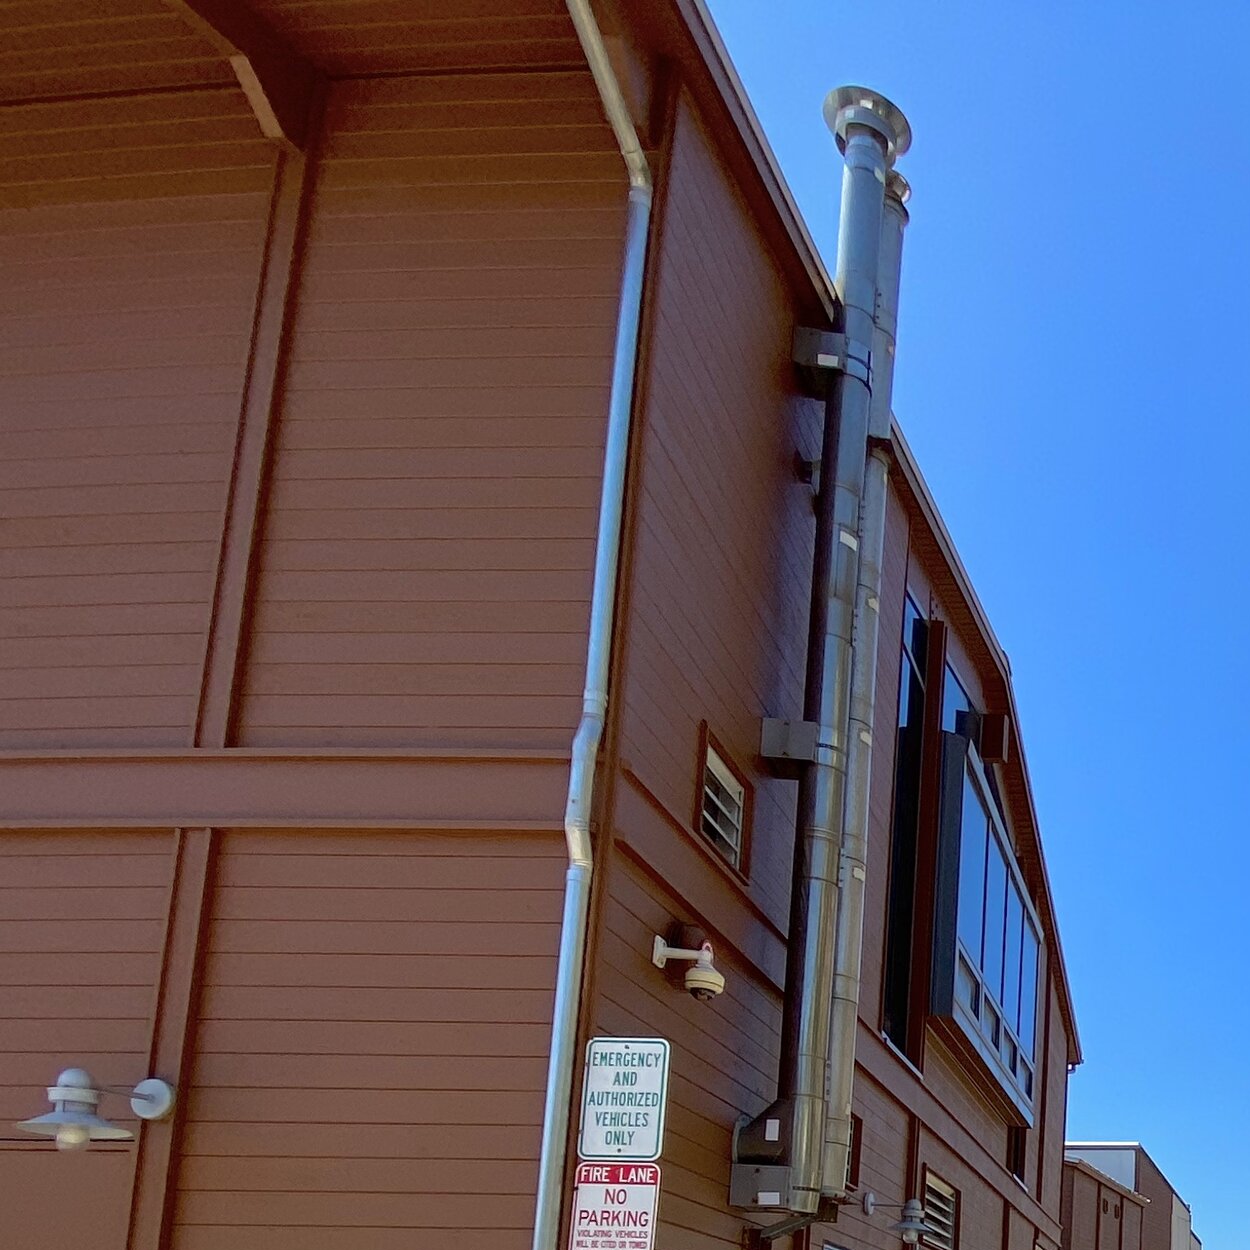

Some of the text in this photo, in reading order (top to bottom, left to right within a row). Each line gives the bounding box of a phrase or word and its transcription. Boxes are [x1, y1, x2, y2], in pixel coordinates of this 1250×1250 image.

[592, 1052, 662, 1067] EMERGENCY
[613, 1071, 638, 1086] AND
[588, 1091, 659, 1107] AUTHORIZED
[595, 1112, 649, 1127] VEHICLES
[605, 1131, 635, 1146] ONLY
[580, 1166, 656, 1183] FIRE LANE
[604, 1188, 627, 1205] NO
[578, 1210, 649, 1227] PARKING
[577, 1229, 648, 1239] VIOLATING VEHICLES
[576, 1240, 648, 1250] WILL BE CITED OR TOWED
